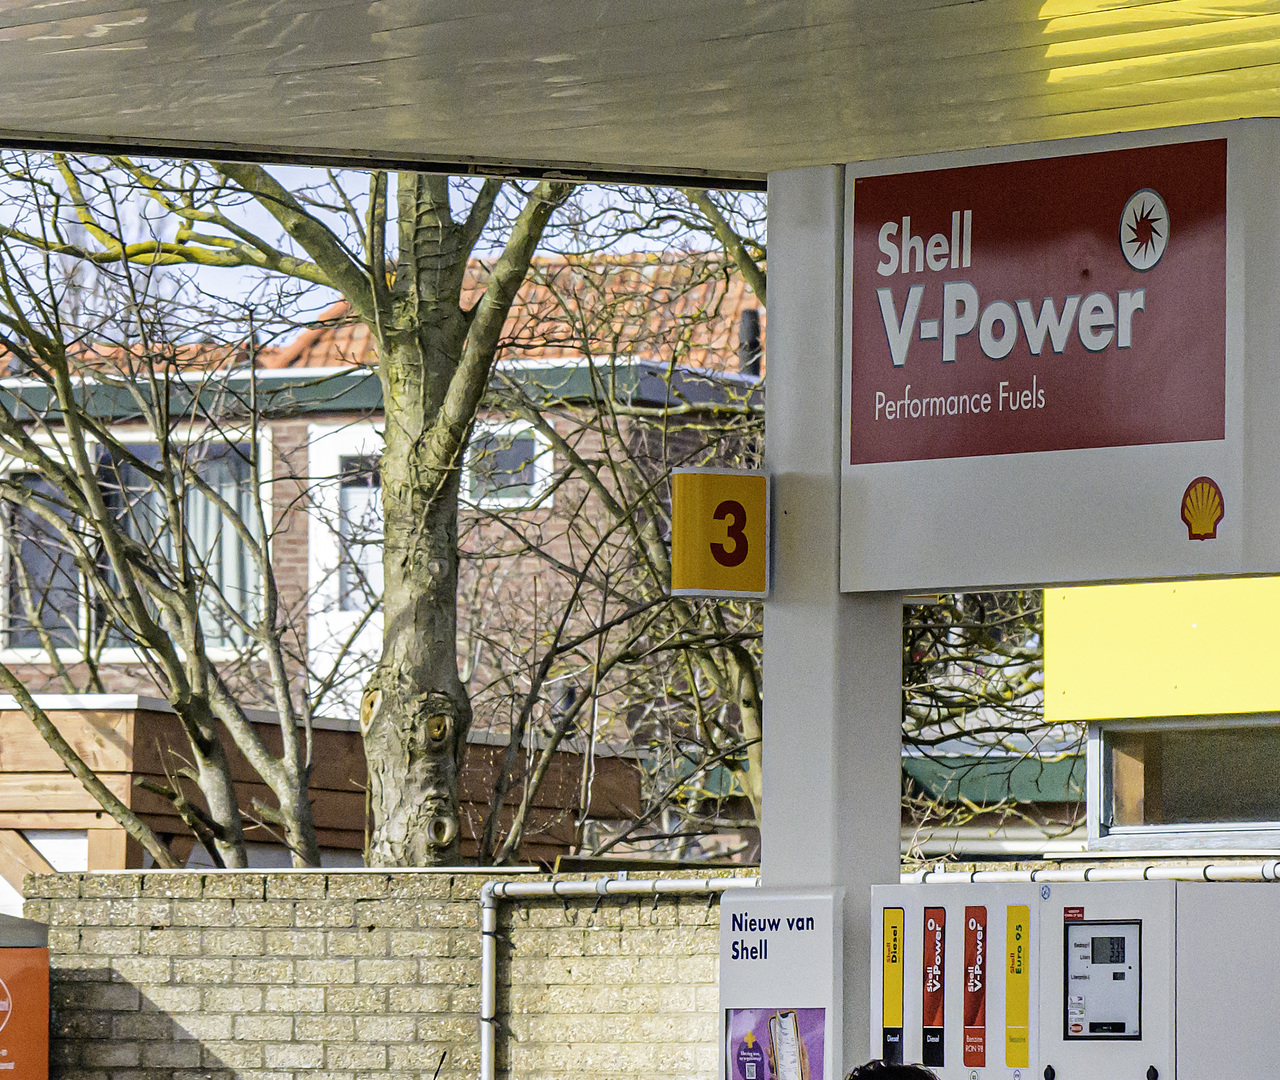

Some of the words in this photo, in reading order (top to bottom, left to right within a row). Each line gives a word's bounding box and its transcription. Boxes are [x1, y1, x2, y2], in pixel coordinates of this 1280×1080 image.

[876, 209, 973, 277] Shell
[876, 281, 1146, 368] V-Power
[875, 384, 992, 421] Performance
[998, 374, 1046, 412] Fuels
[709, 499, 749, 568] 3
[731, 911, 781, 932] Nieuw
[786, 916, 815, 931] van
[731, 939, 768, 960] Shell
[1015, 924, 1023, 941] 95
[932, 923, 942, 992] V-Power
[974, 923, 984, 992] V-Power
[1015, 945, 1023, 974] Euro
